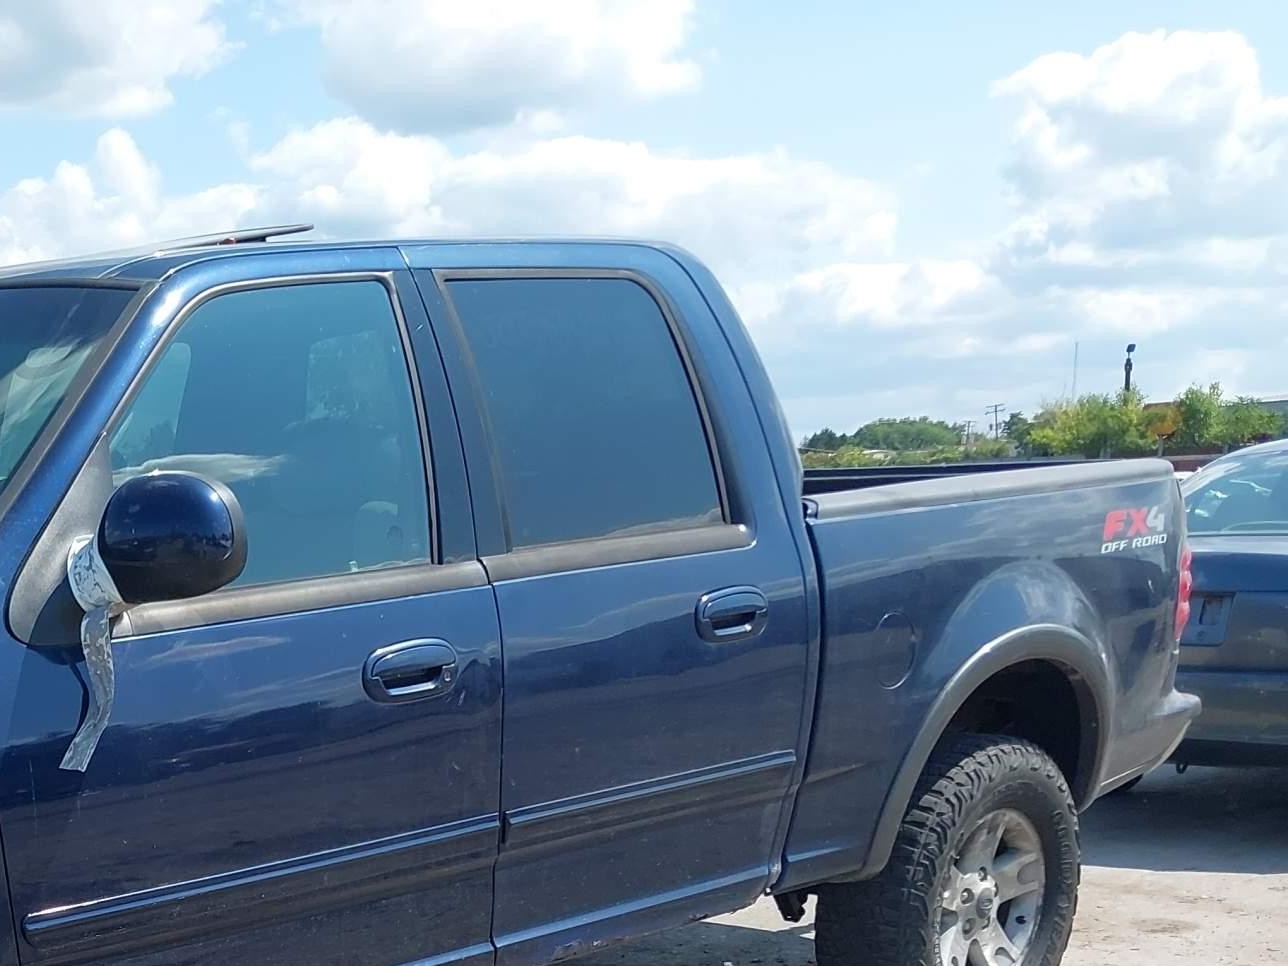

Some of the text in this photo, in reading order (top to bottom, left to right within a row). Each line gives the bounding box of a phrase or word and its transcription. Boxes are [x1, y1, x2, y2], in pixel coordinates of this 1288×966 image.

[1103, 505, 1165, 542] FX4
[1100, 533, 1168, 554] OFF ROAD
